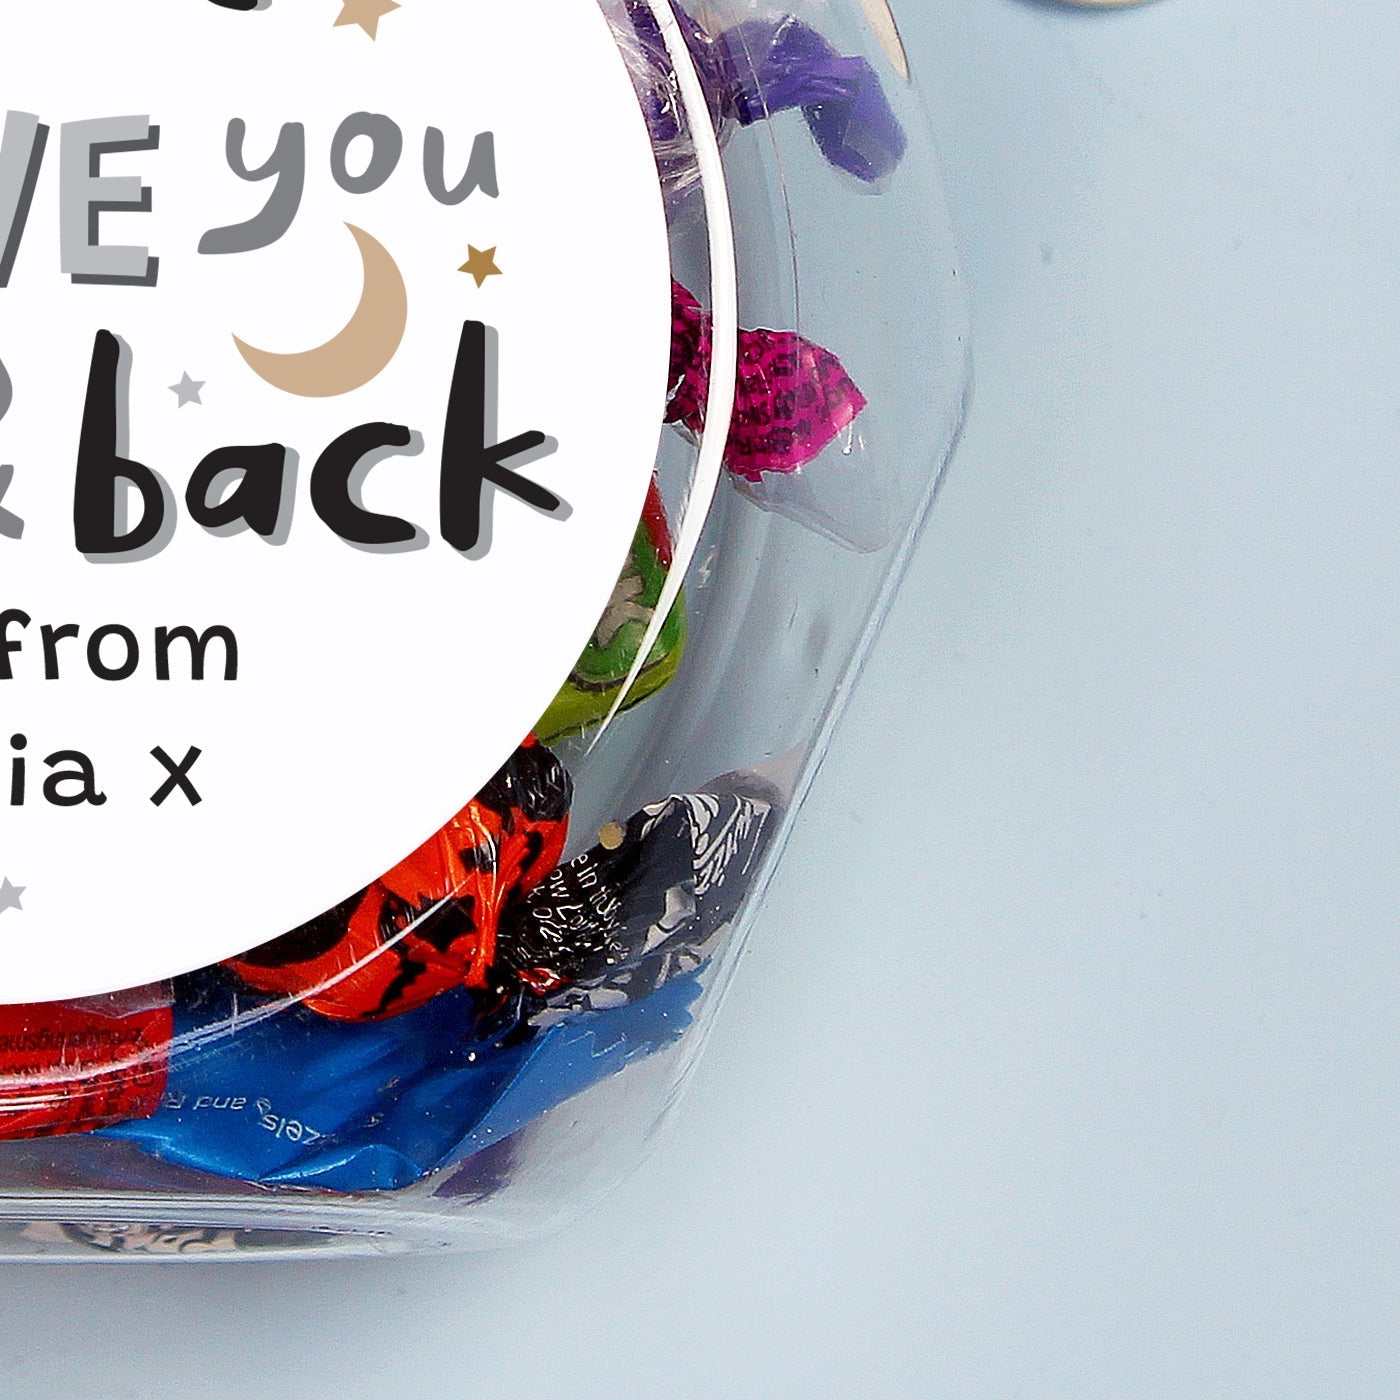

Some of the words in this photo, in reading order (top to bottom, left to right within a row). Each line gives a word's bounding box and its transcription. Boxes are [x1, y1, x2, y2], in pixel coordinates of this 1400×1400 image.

[197, 111, 499, 255] you
[73, 320, 573, 564] back
[149, 745, 202, 807] x
[193, 1095, 247, 1111] and
